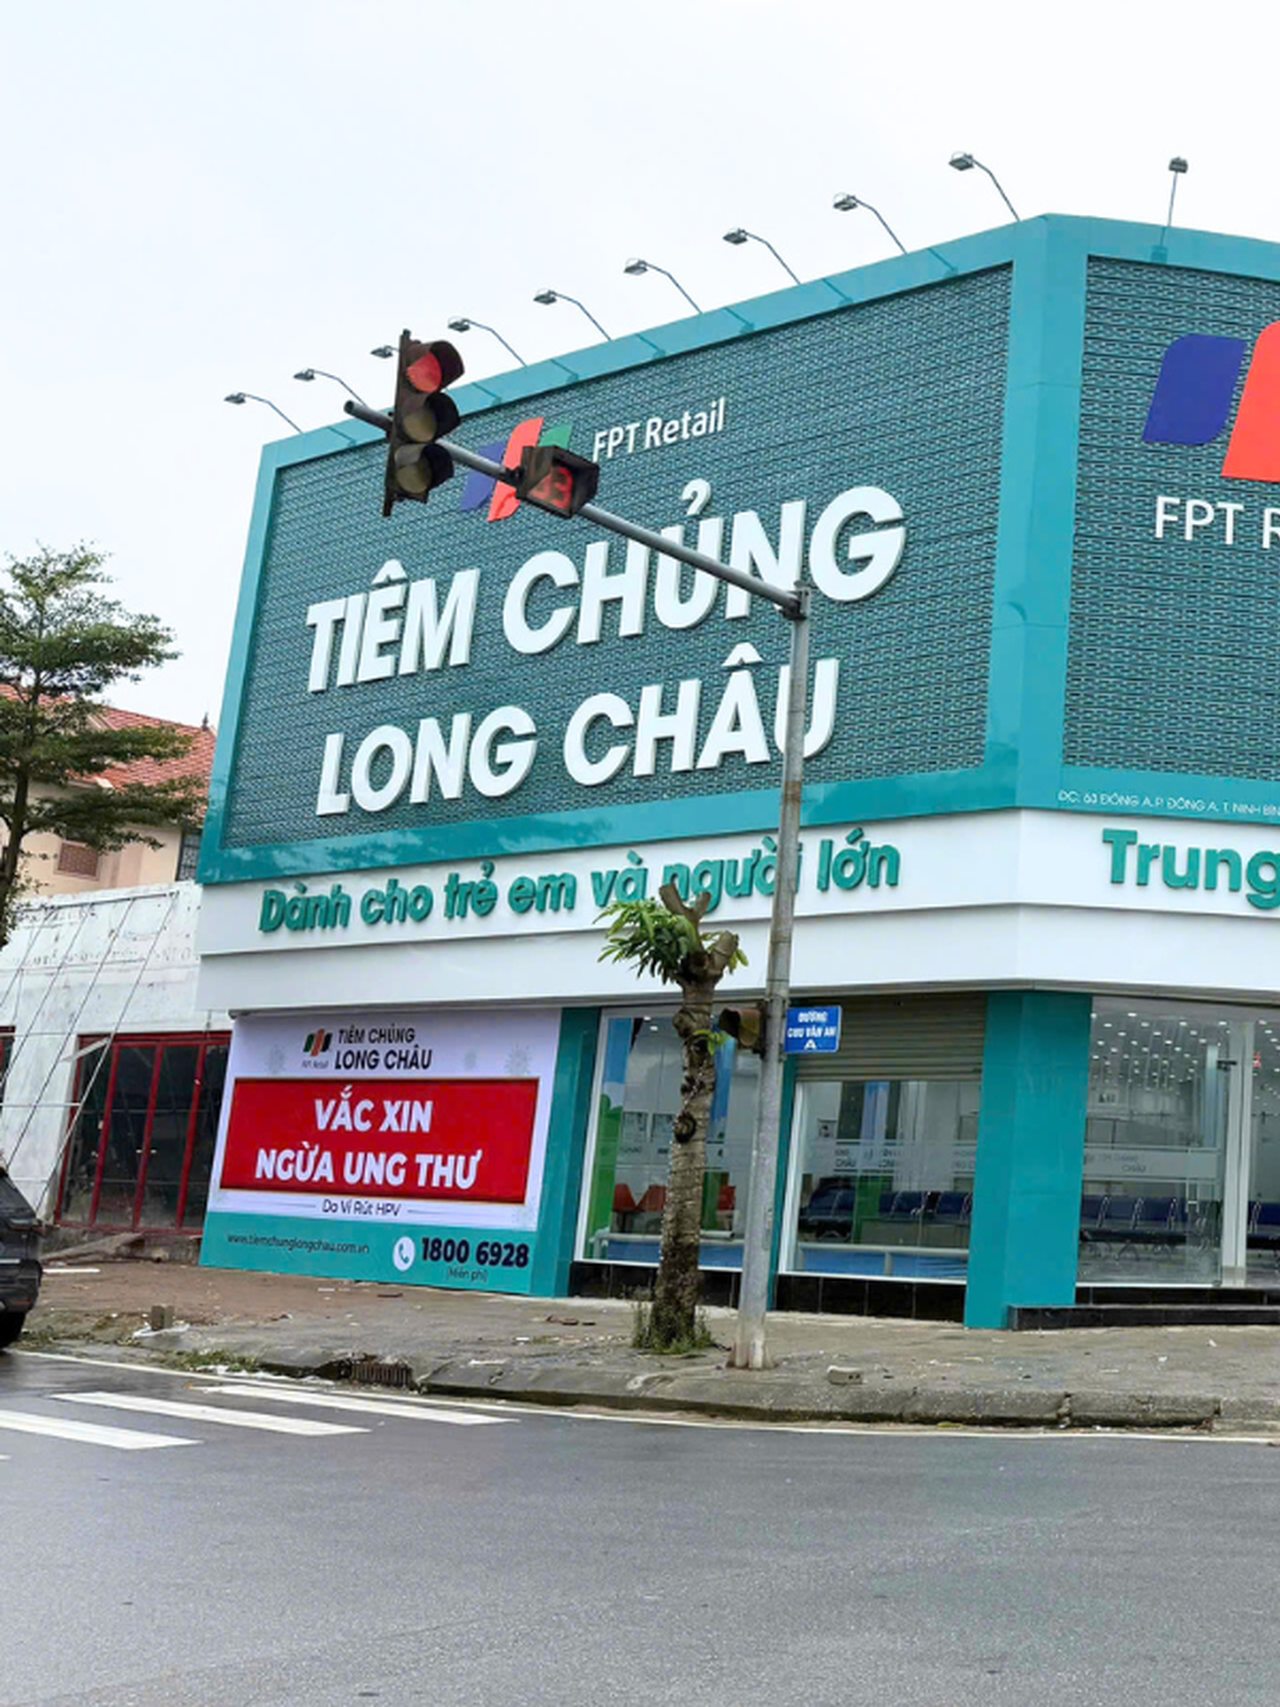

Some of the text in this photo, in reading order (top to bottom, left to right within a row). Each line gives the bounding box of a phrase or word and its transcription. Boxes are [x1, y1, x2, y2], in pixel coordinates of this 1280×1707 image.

[593, 397, 725, 463] FPT Retail
[1154, 495, 1245, 545] FPT
[306, 479, 906, 693] TIÊM CHỦNG
[316, 640, 840, 817] LONG CHÂU
[259, 882, 352, 932] Dành
[360, 878, 433, 926] cho
[443, 861, 498, 920] trẻ
[508, 870, 577, 914] em
[590, 850, 649, 907] và
[817, 826, 901, 892] lớn
[335, 1043, 432, 1070] LONG CHÂU
[338, 1025, 366, 1044] TIÊM
[314, 1084, 433, 1133] VẮC XIN
[255, 1141, 483, 1190] NGỪA UNG THƯ
[322, 1199, 338, 1214] Do
[375, 1202, 402, 1216] HPV
[421, 1237, 530, 1268] 1800 6928
